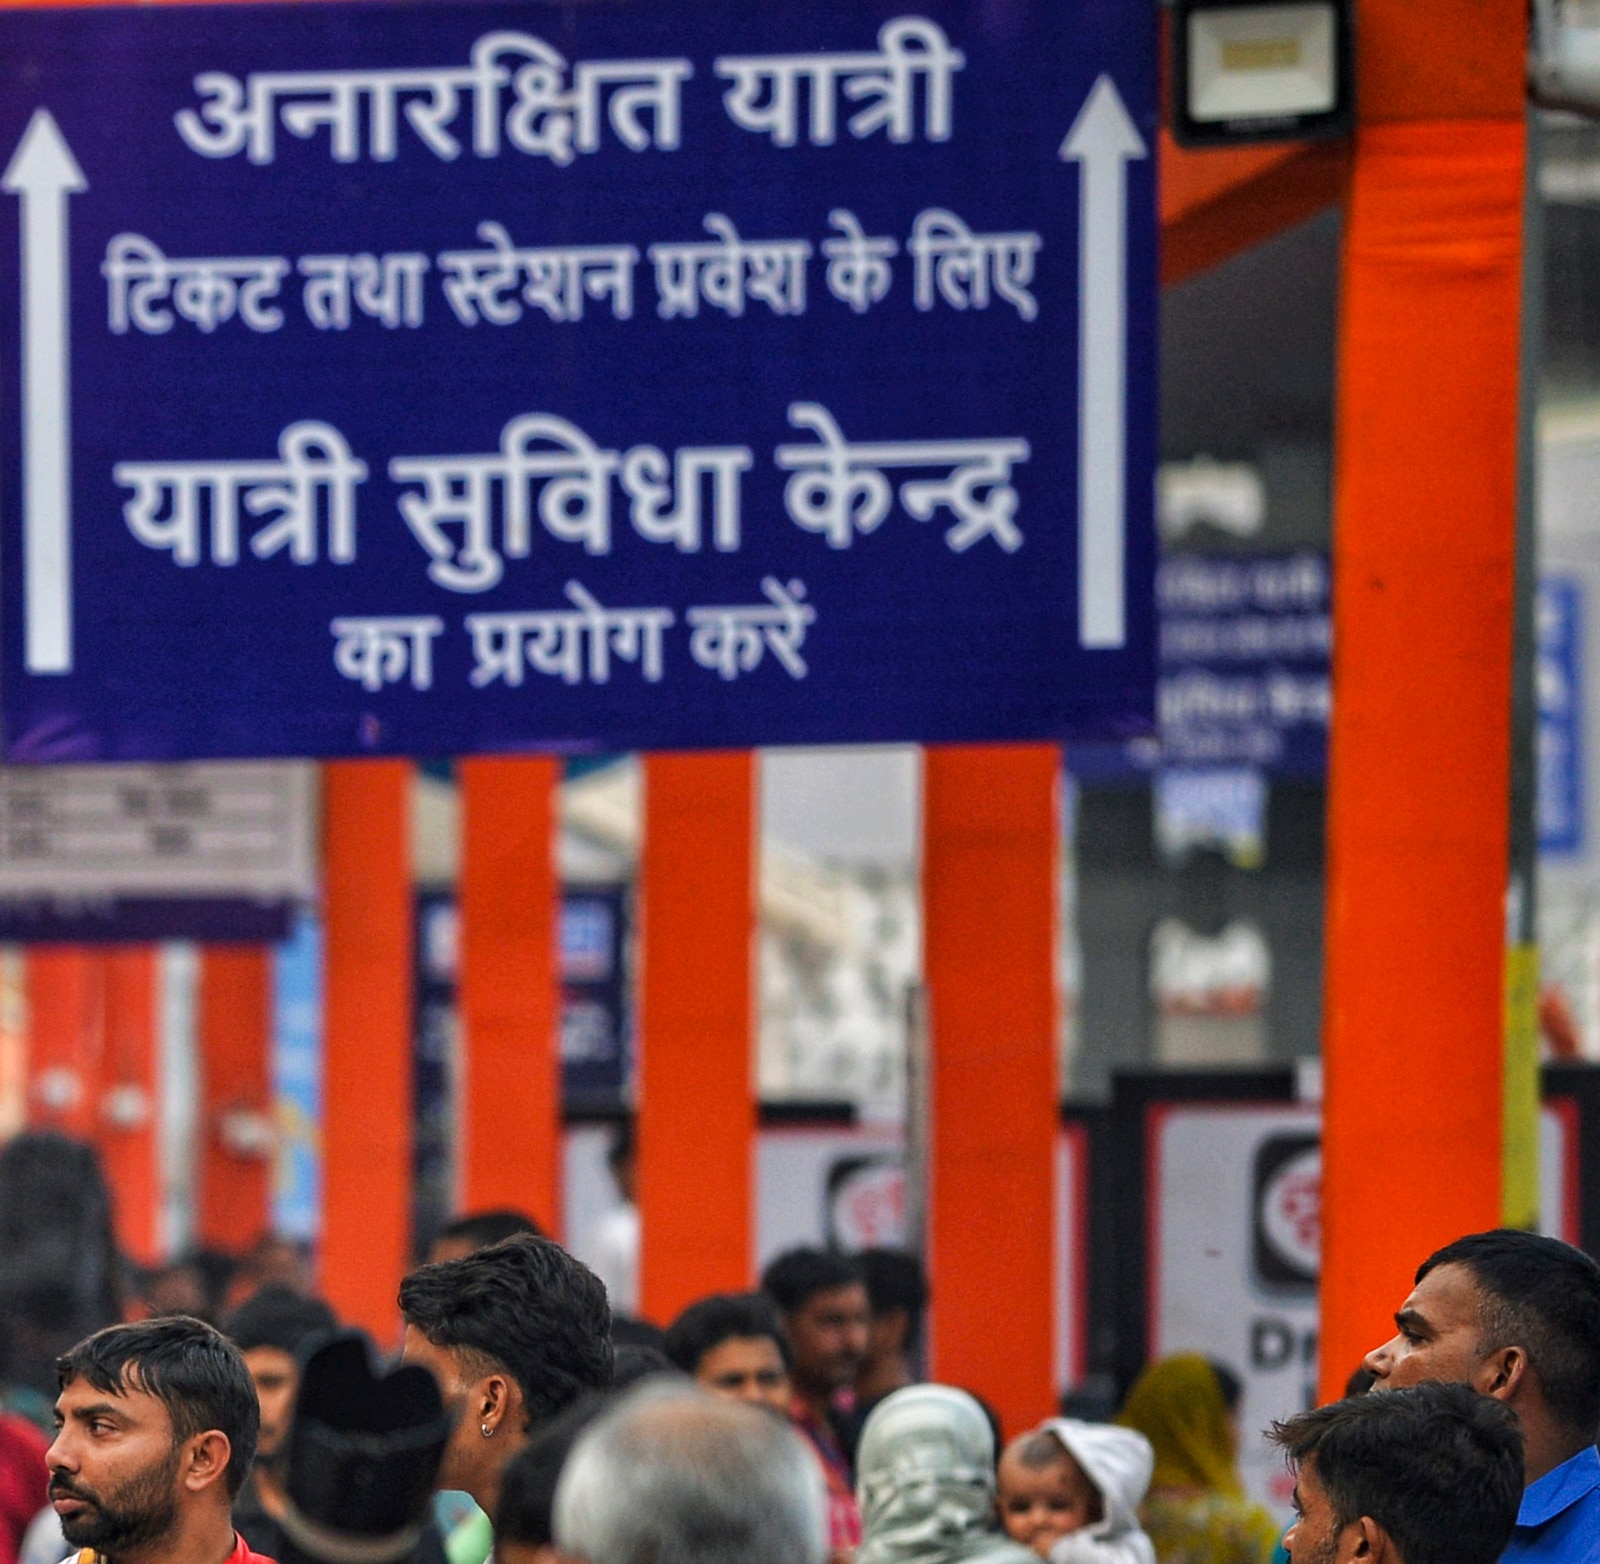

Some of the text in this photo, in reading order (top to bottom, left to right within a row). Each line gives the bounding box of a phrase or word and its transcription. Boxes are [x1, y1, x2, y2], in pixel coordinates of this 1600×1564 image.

[175, 17, 963, 164] अनारक्षित यात्री
[101, 209, 1039, 333] टिकट तथा स्टेशन प्रवेश के लिए
[113, 403, 1029, 593] यात्री सुविधा केन्द्र
[331, 577, 815, 692] का प्रयोग करें
